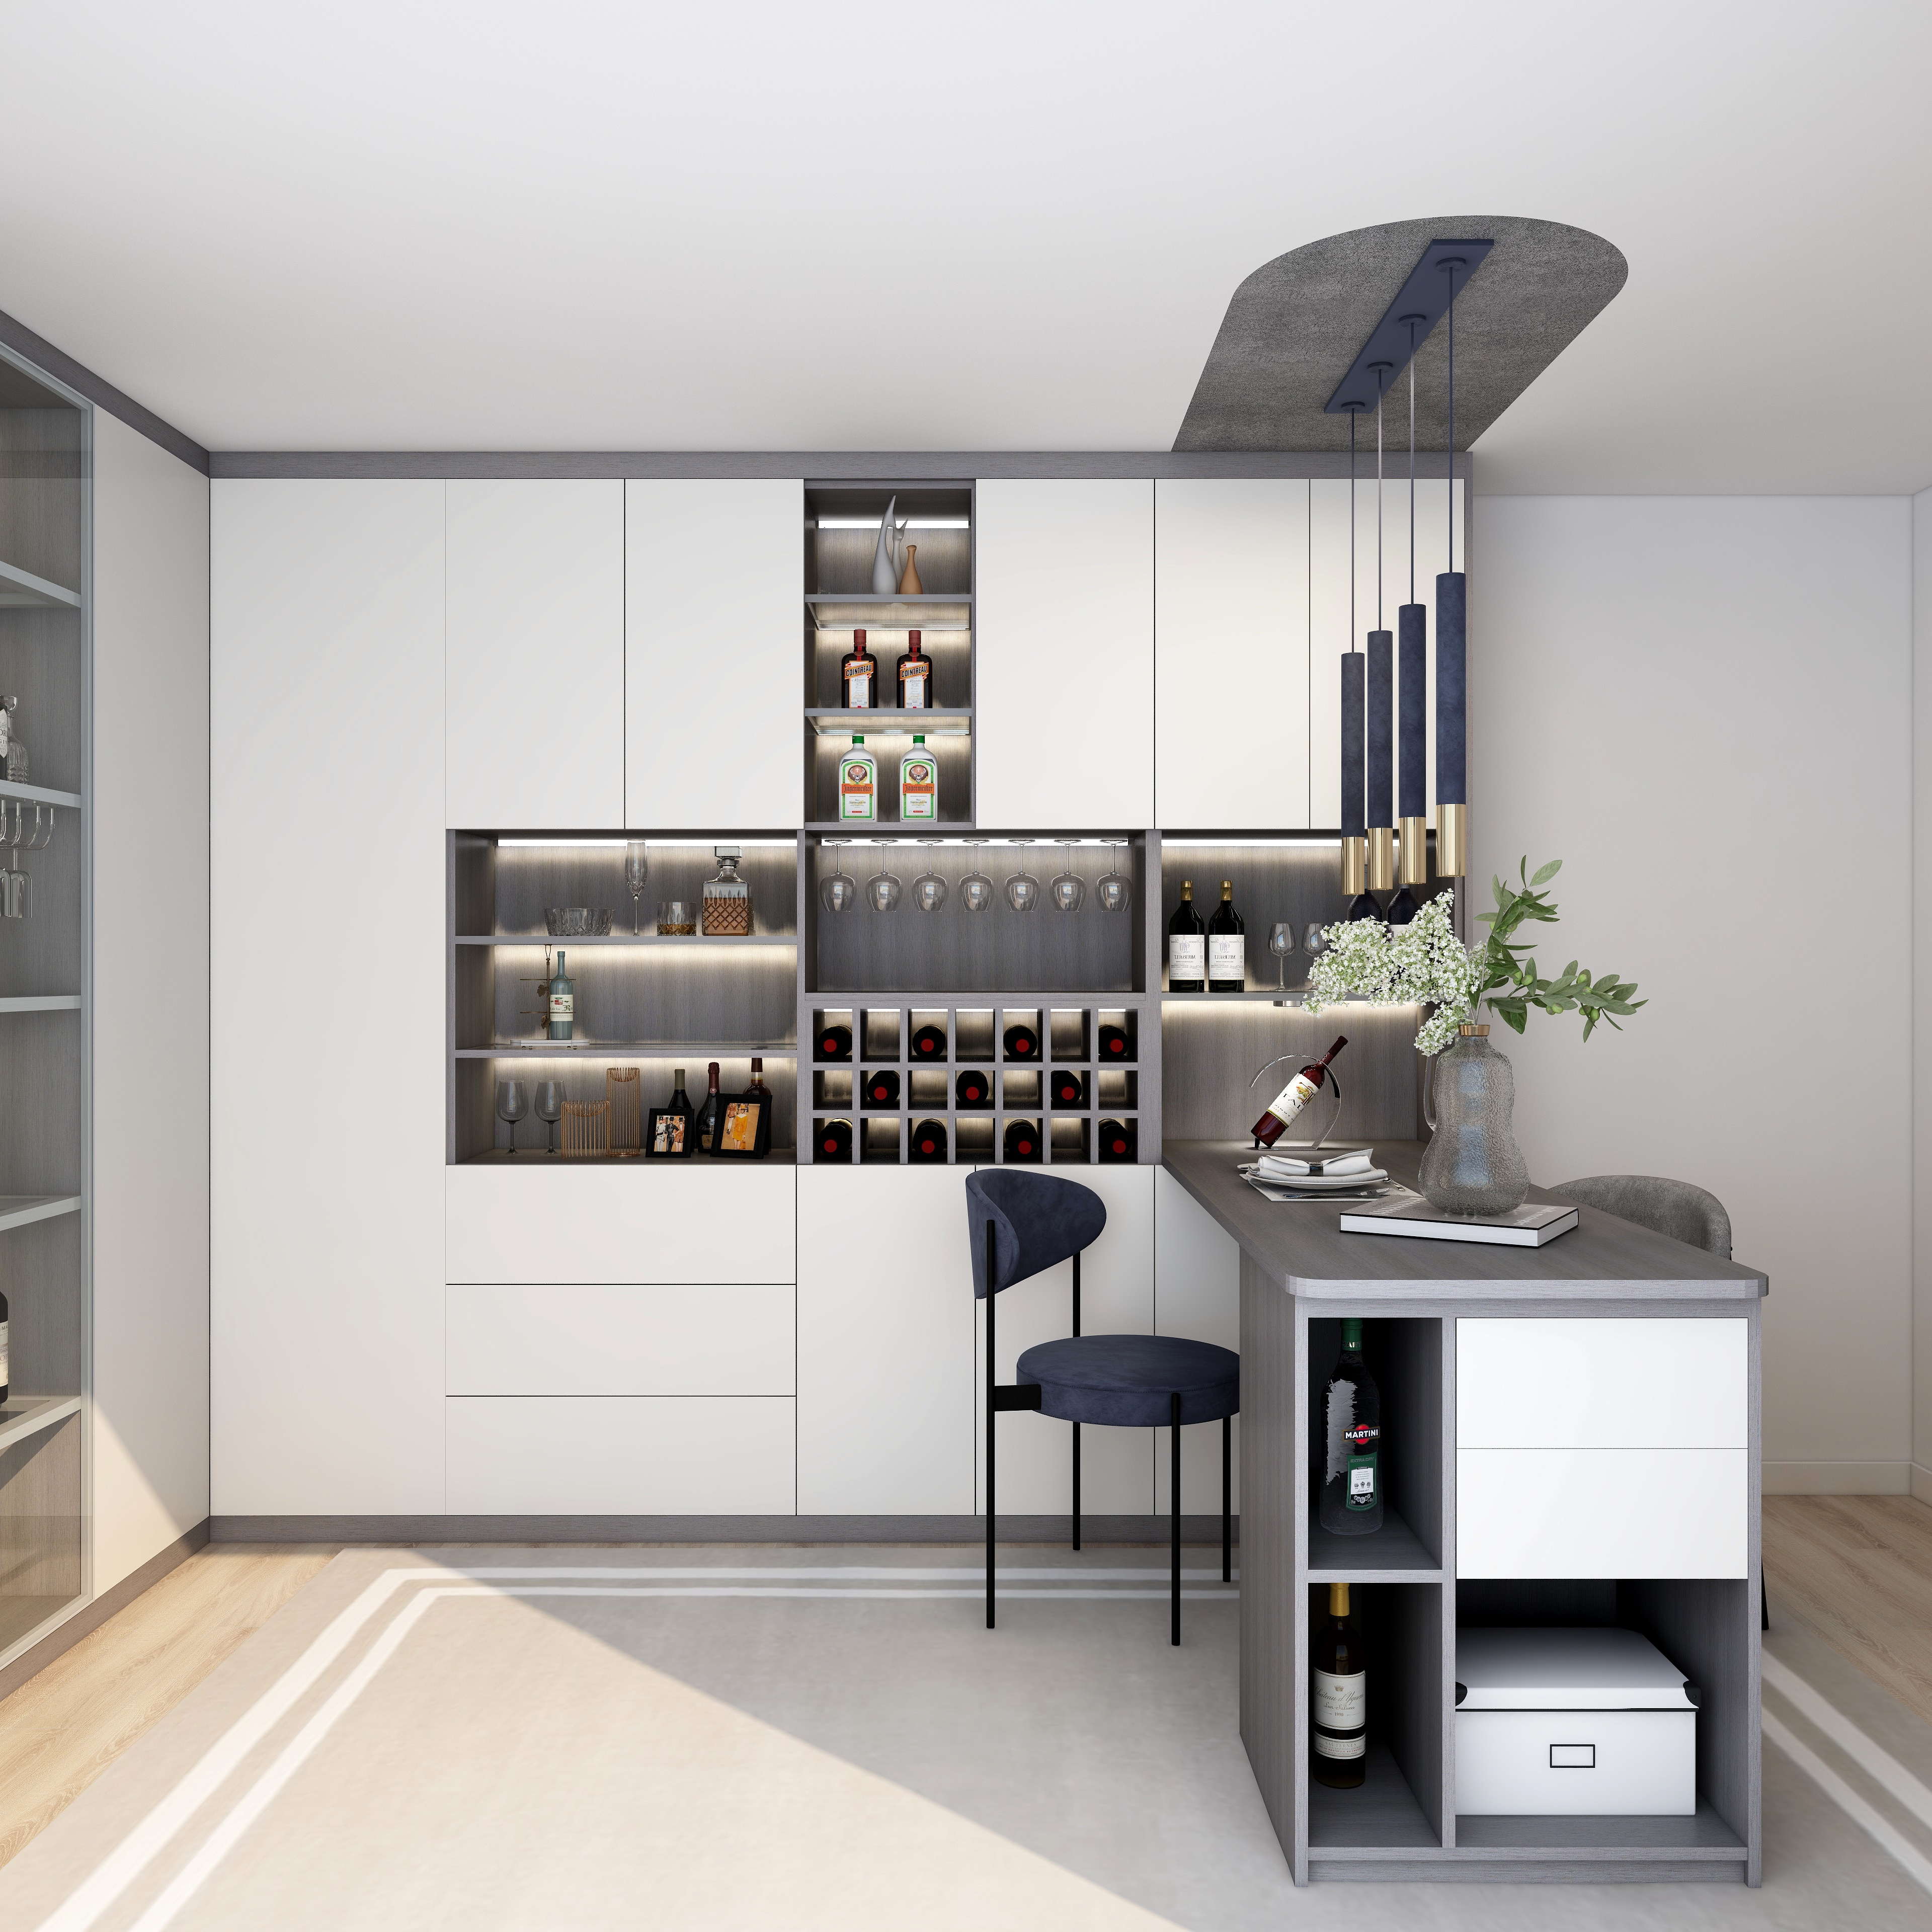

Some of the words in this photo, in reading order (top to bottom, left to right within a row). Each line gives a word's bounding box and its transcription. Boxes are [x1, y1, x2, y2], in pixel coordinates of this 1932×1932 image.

[846, 665, 871, 677] COINTREAU
[902, 666, 927, 678] COINTREAU
[1345, 1429, 1378, 1439] MARTINI
